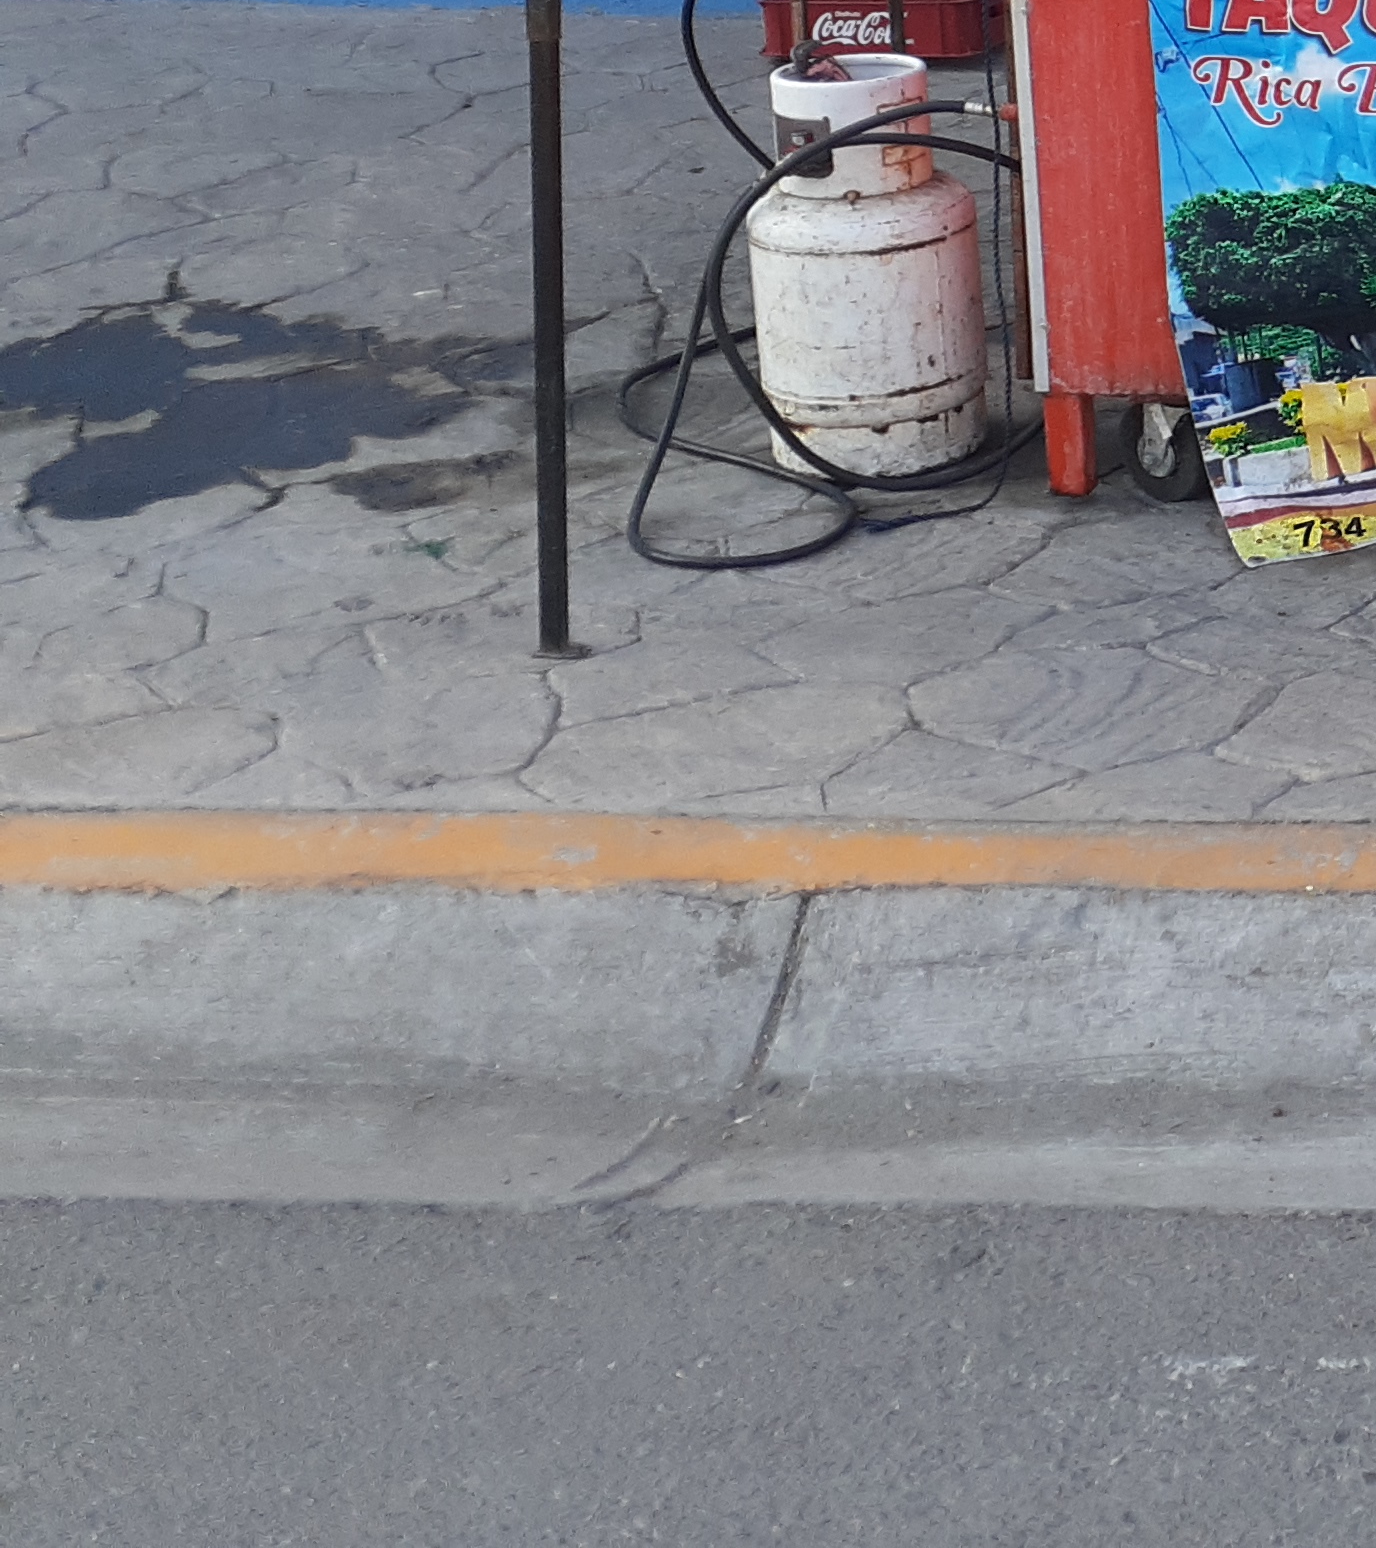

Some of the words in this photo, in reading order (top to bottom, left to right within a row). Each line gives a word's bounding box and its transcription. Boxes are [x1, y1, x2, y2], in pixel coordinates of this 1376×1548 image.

[812, 11, 898, 46] Coca-Col
[1193, 54, 1322, 128] Rica
[1292, 516, 1367, 549] 734
